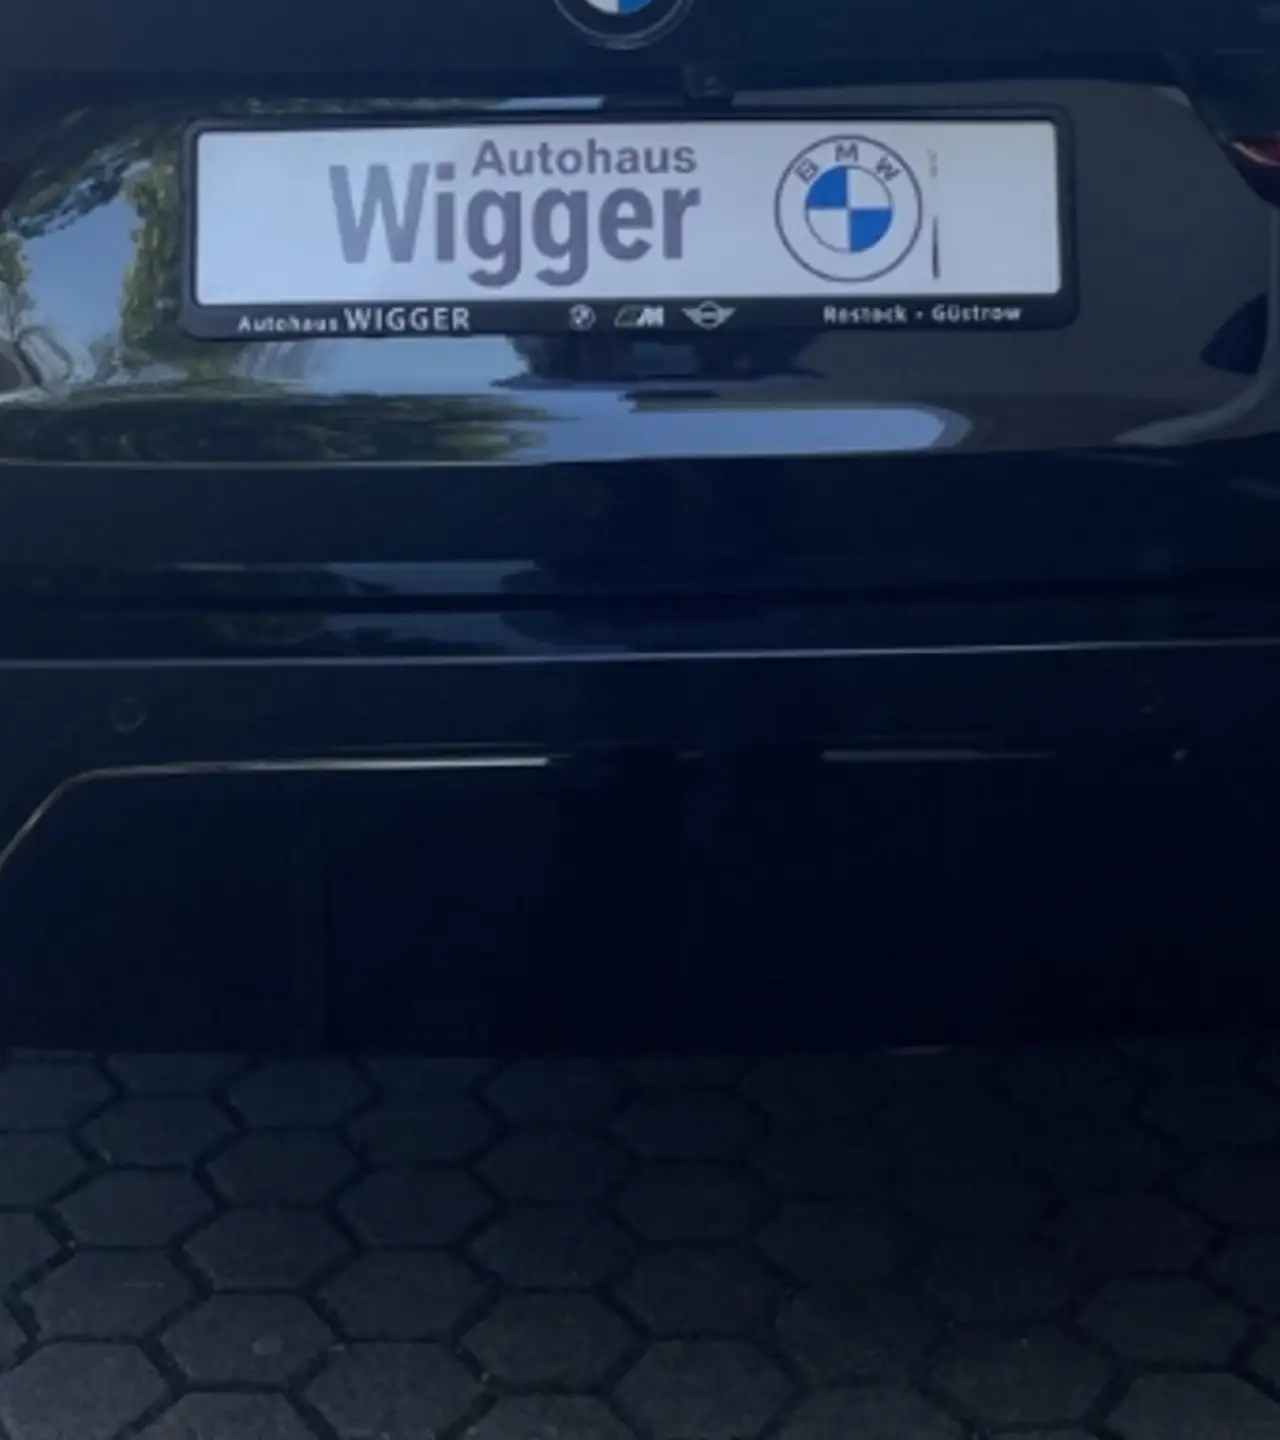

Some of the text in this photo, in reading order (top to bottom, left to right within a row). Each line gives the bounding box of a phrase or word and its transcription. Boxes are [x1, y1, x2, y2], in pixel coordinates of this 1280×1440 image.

[471, 138, 698, 177] Autohaus
[794, 143, 901, 184] BMW
[328, 161, 701, 288] Wigger
[237, 307, 470, 332] Autohaus WIGGER
